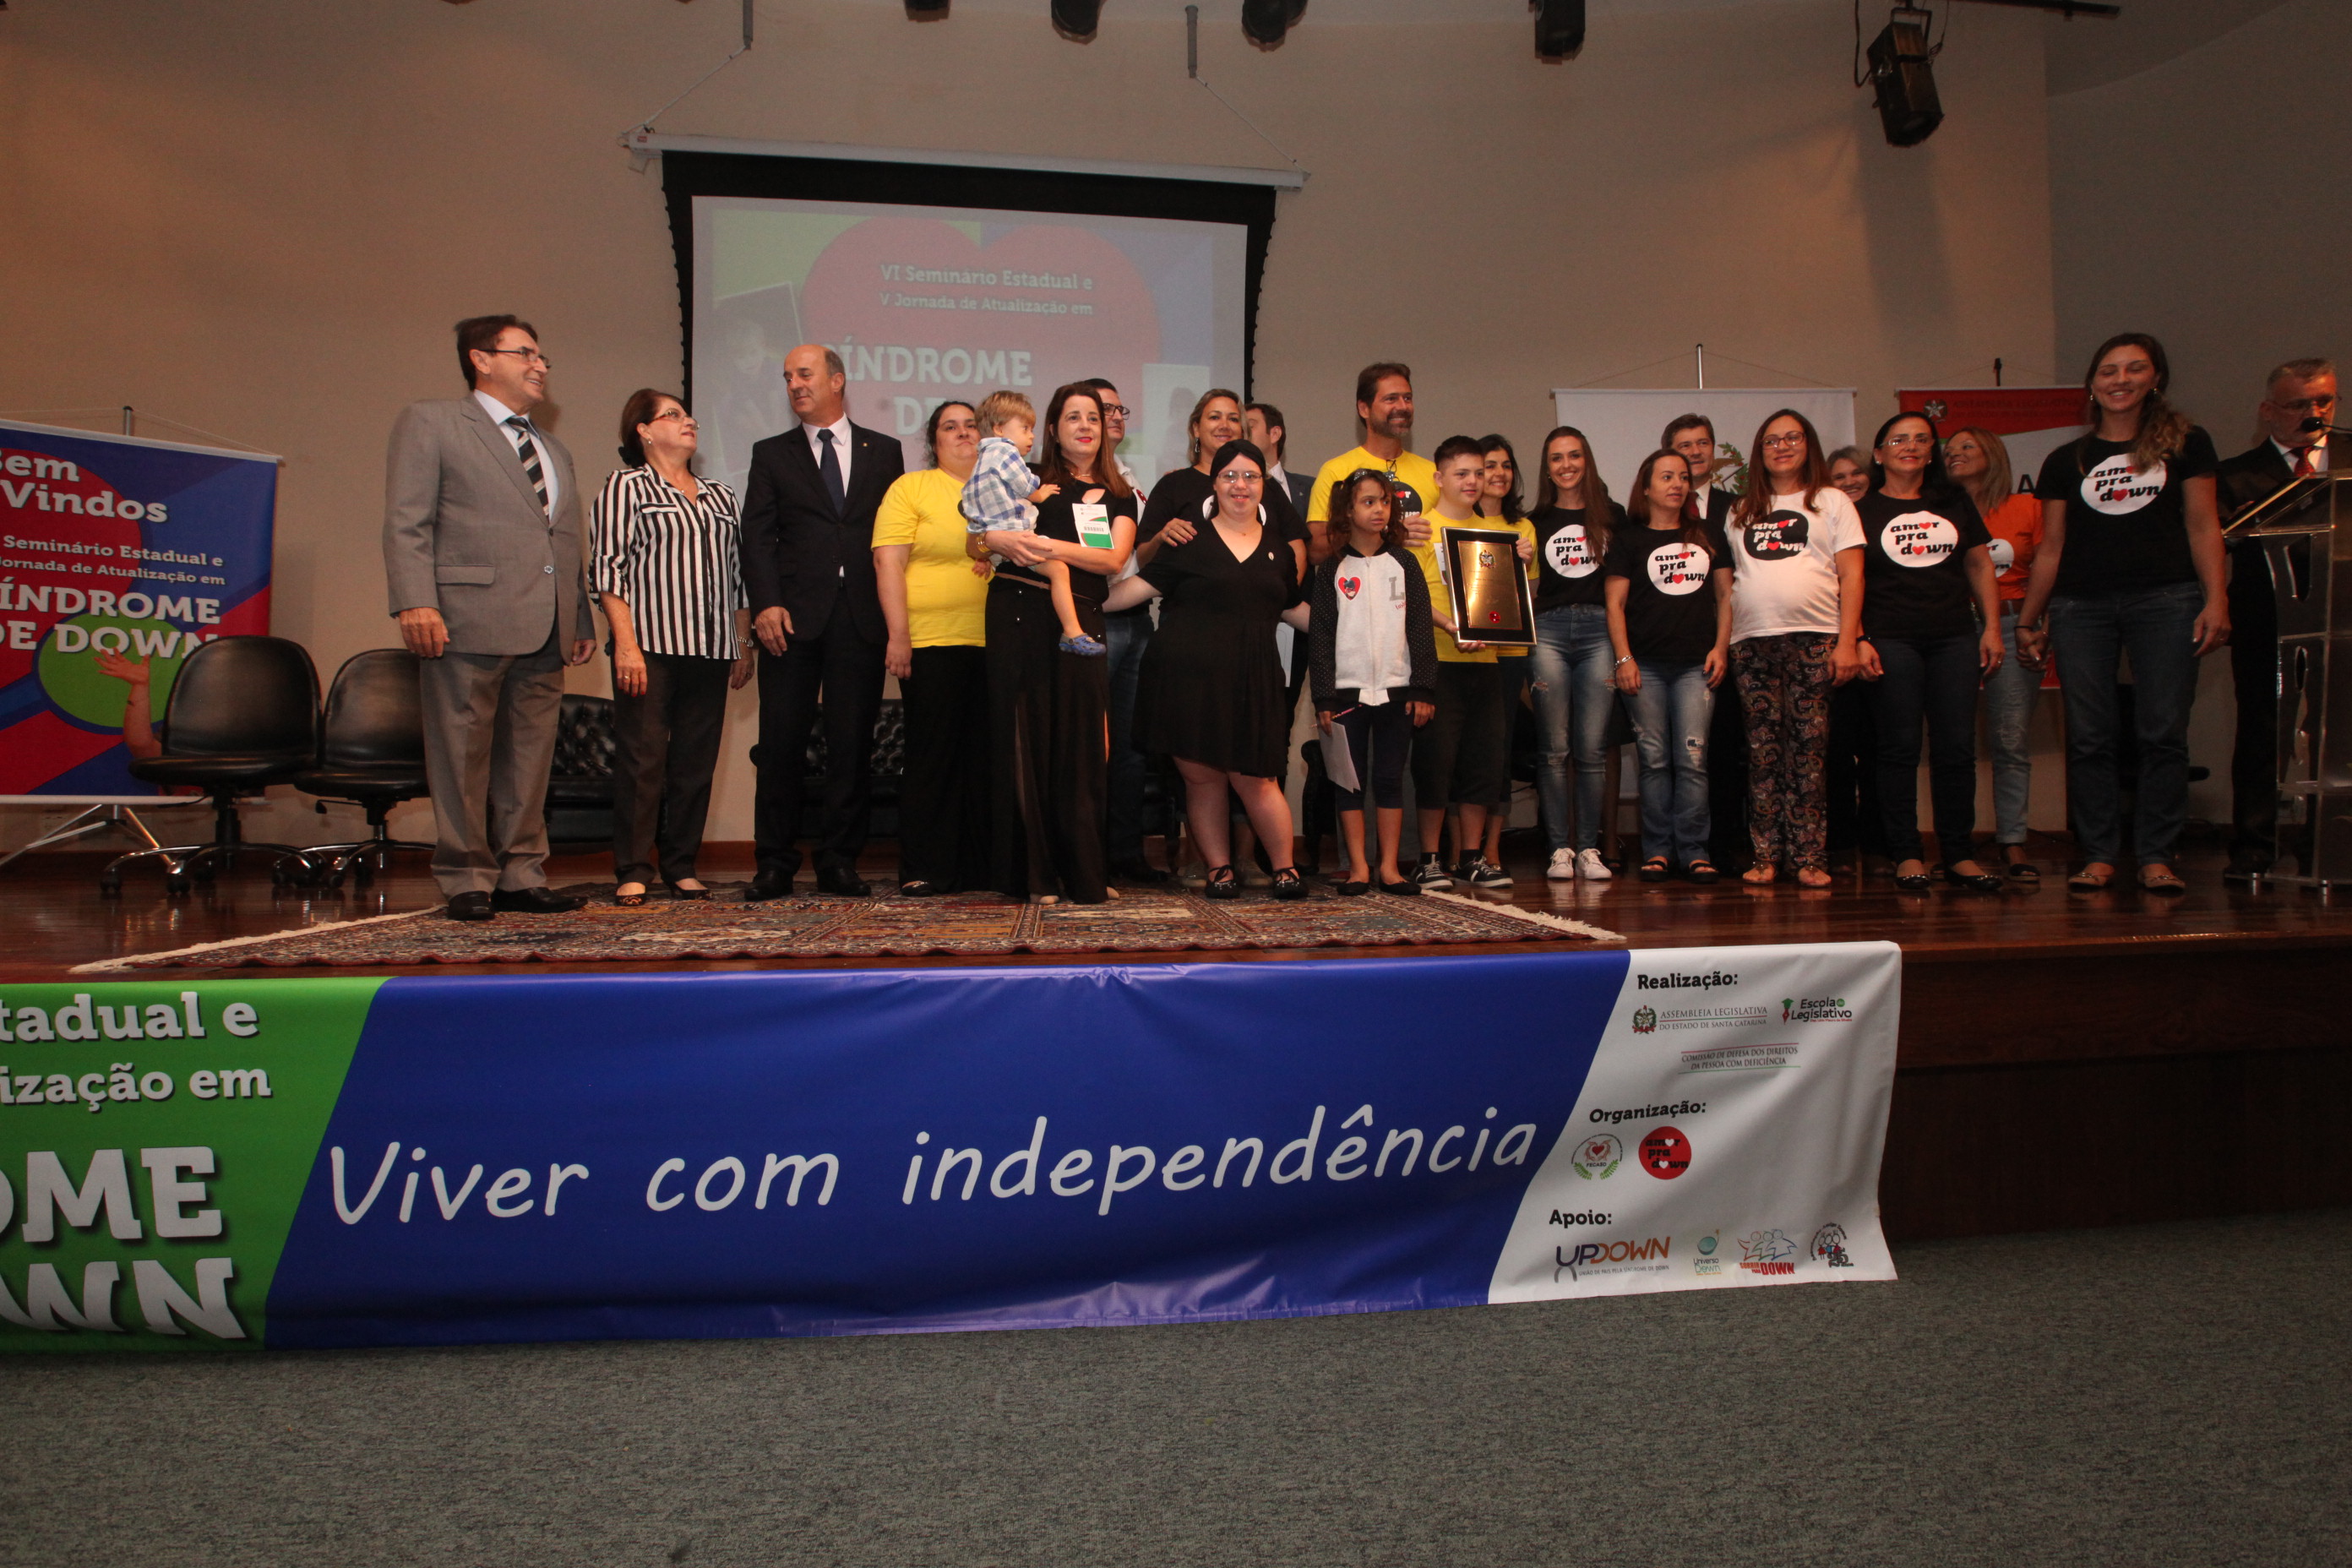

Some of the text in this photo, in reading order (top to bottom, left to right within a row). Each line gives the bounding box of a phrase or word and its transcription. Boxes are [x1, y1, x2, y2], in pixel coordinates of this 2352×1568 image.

[880, 264, 1092, 291] VI Seminário Estadual e
[894, 293, 956, 310] Jornada
[960, 297, 977, 310] de
[981, 298, 1068, 316] Atualização
[1070, 302, 1093, 315] em
[824, 335, 1032, 386] ÍNDROME
[0, 449, 80, 482] em
[2094, 474, 2133, 492] pra
[0, 479, 168, 523] Vindos
[1754, 530, 1783, 543] pra
[1895, 531, 1929, 546] pra
[3, 535, 224, 567] Seminário Estadual e
[1555, 544, 1582, 557] pra
[0, 556, 226, 585] ornada de Atualização em
[1659, 560, 1687, 575] pra
[0, 619, 37, 651] E
[1637, 971, 1738, 990] Realização:
[1660, 1006, 1767, 1019] ASSEMBLEIA LEGISLATIVA
[1800, 997, 1836, 1010] Escola
[222, 1002, 259, 1037] e
[1734, 1019, 1767, 1027] CATARINA
[1791, 1007, 1853, 1022] Legislativo
[1751, 1048, 1765, 1056] DOS
[1767, 1046, 1798, 1055] DIREITOS
[1726, 1059, 1742, 1068] COM
[188, 1068, 272, 1099] em
[1589, 1100, 1707, 1124] Organização:
[1647, 1149, 1671, 1159] pra
[330, 1103, 1537, 1225] Viver com independência
[0, 1146, 222, 1242] ME
[1549, 1209, 1612, 1228] Apoio:
[1760, 1261, 1795, 1276] DOWN
